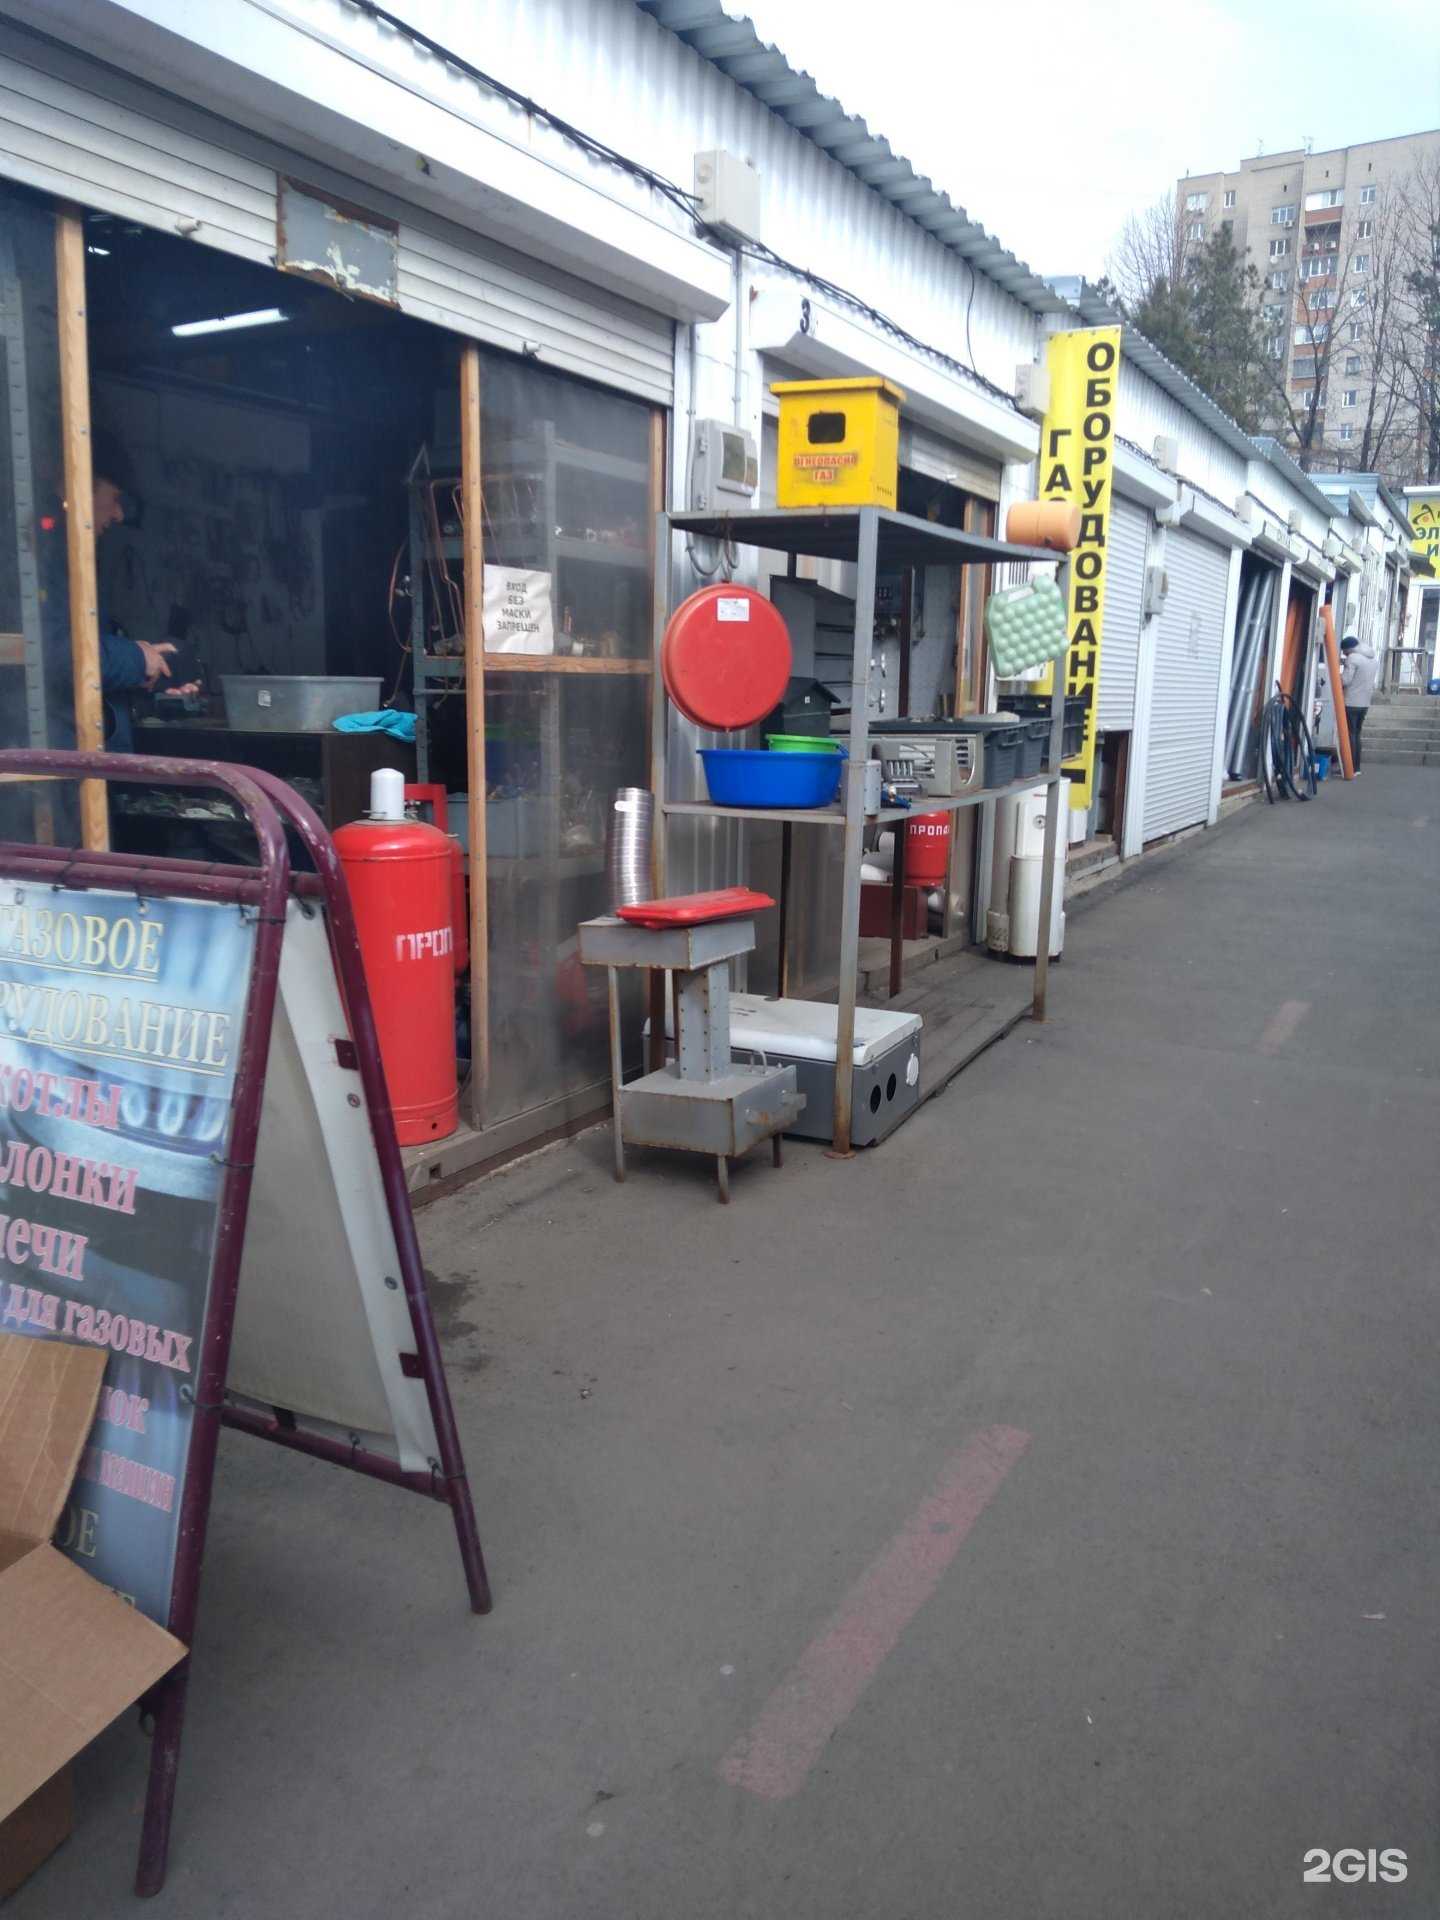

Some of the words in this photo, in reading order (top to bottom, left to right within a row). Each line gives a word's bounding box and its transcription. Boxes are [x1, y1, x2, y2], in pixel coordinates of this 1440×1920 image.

[1066, 341, 1116, 742] ОБОРУДОВАНИ
[506, 581, 528, 593] ВХОД
[507, 595, 525, 605] БЕЗ
[501, 608, 531, 618] МАСКИ
[64, 1299, 193, 1373] газовых
